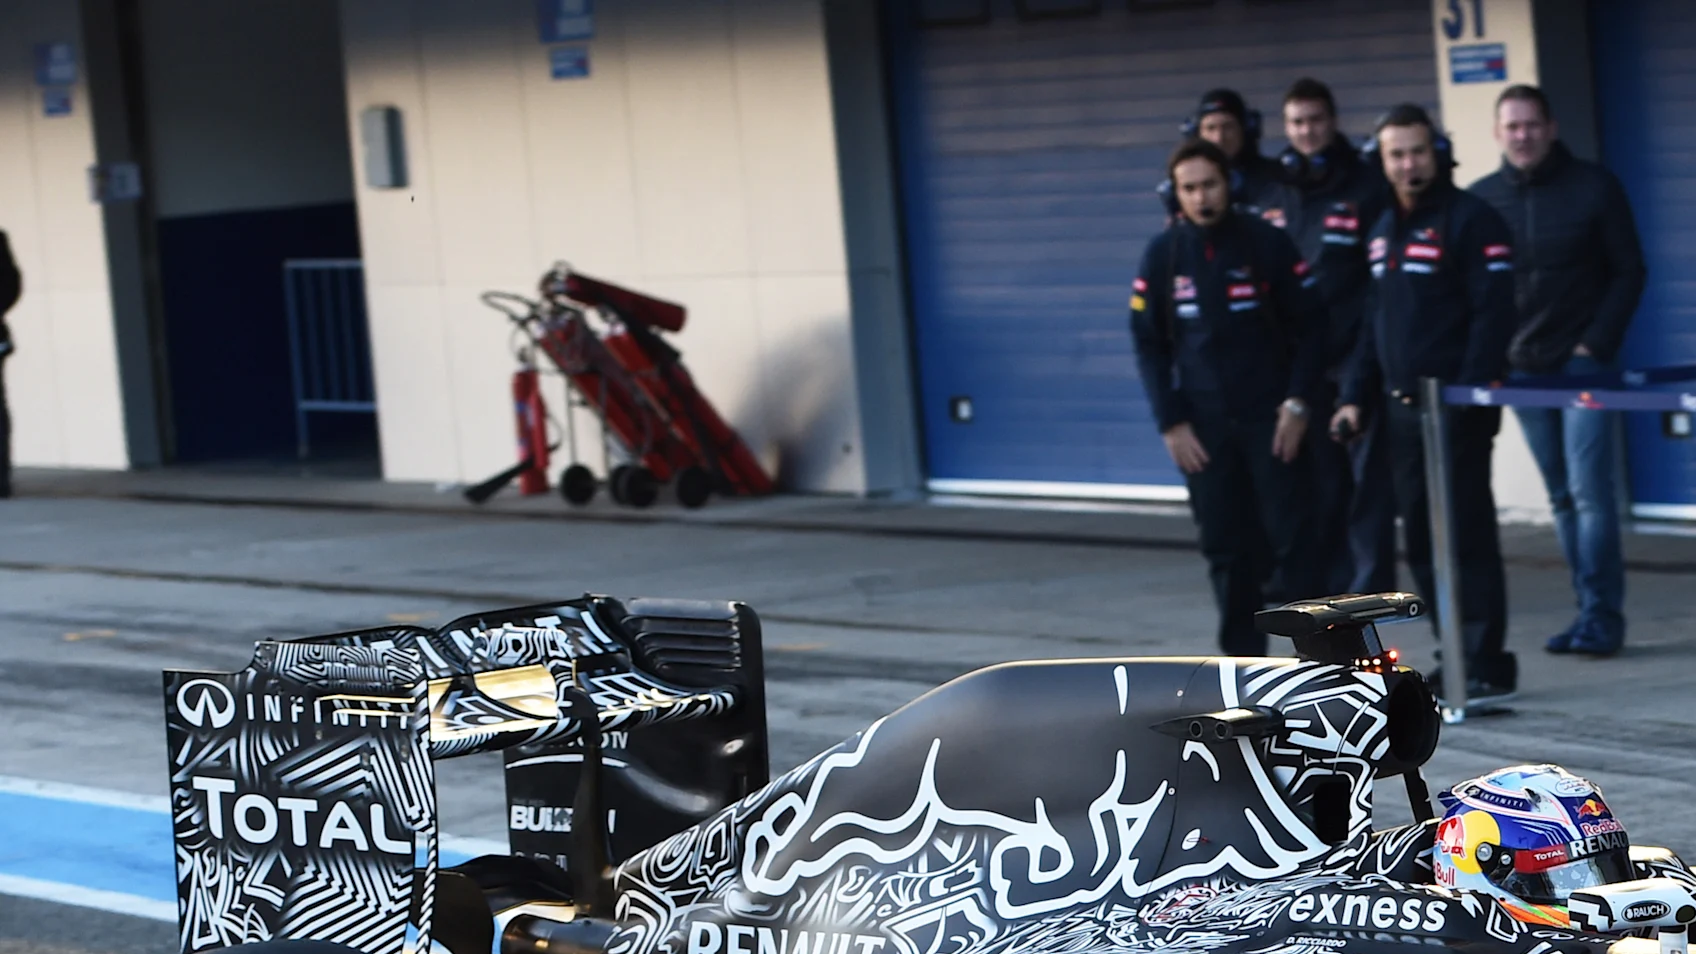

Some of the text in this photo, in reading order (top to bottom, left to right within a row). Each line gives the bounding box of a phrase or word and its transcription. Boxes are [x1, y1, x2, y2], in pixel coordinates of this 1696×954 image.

[192, 775, 412, 854] TOTAL
[1534, 850, 1565, 862] TOTAL
[1288, 891, 1448, 932] exness
[1632, 903, 1665, 919] RAUCH
[1296, 936, 1347, 948] RICCIARDO
